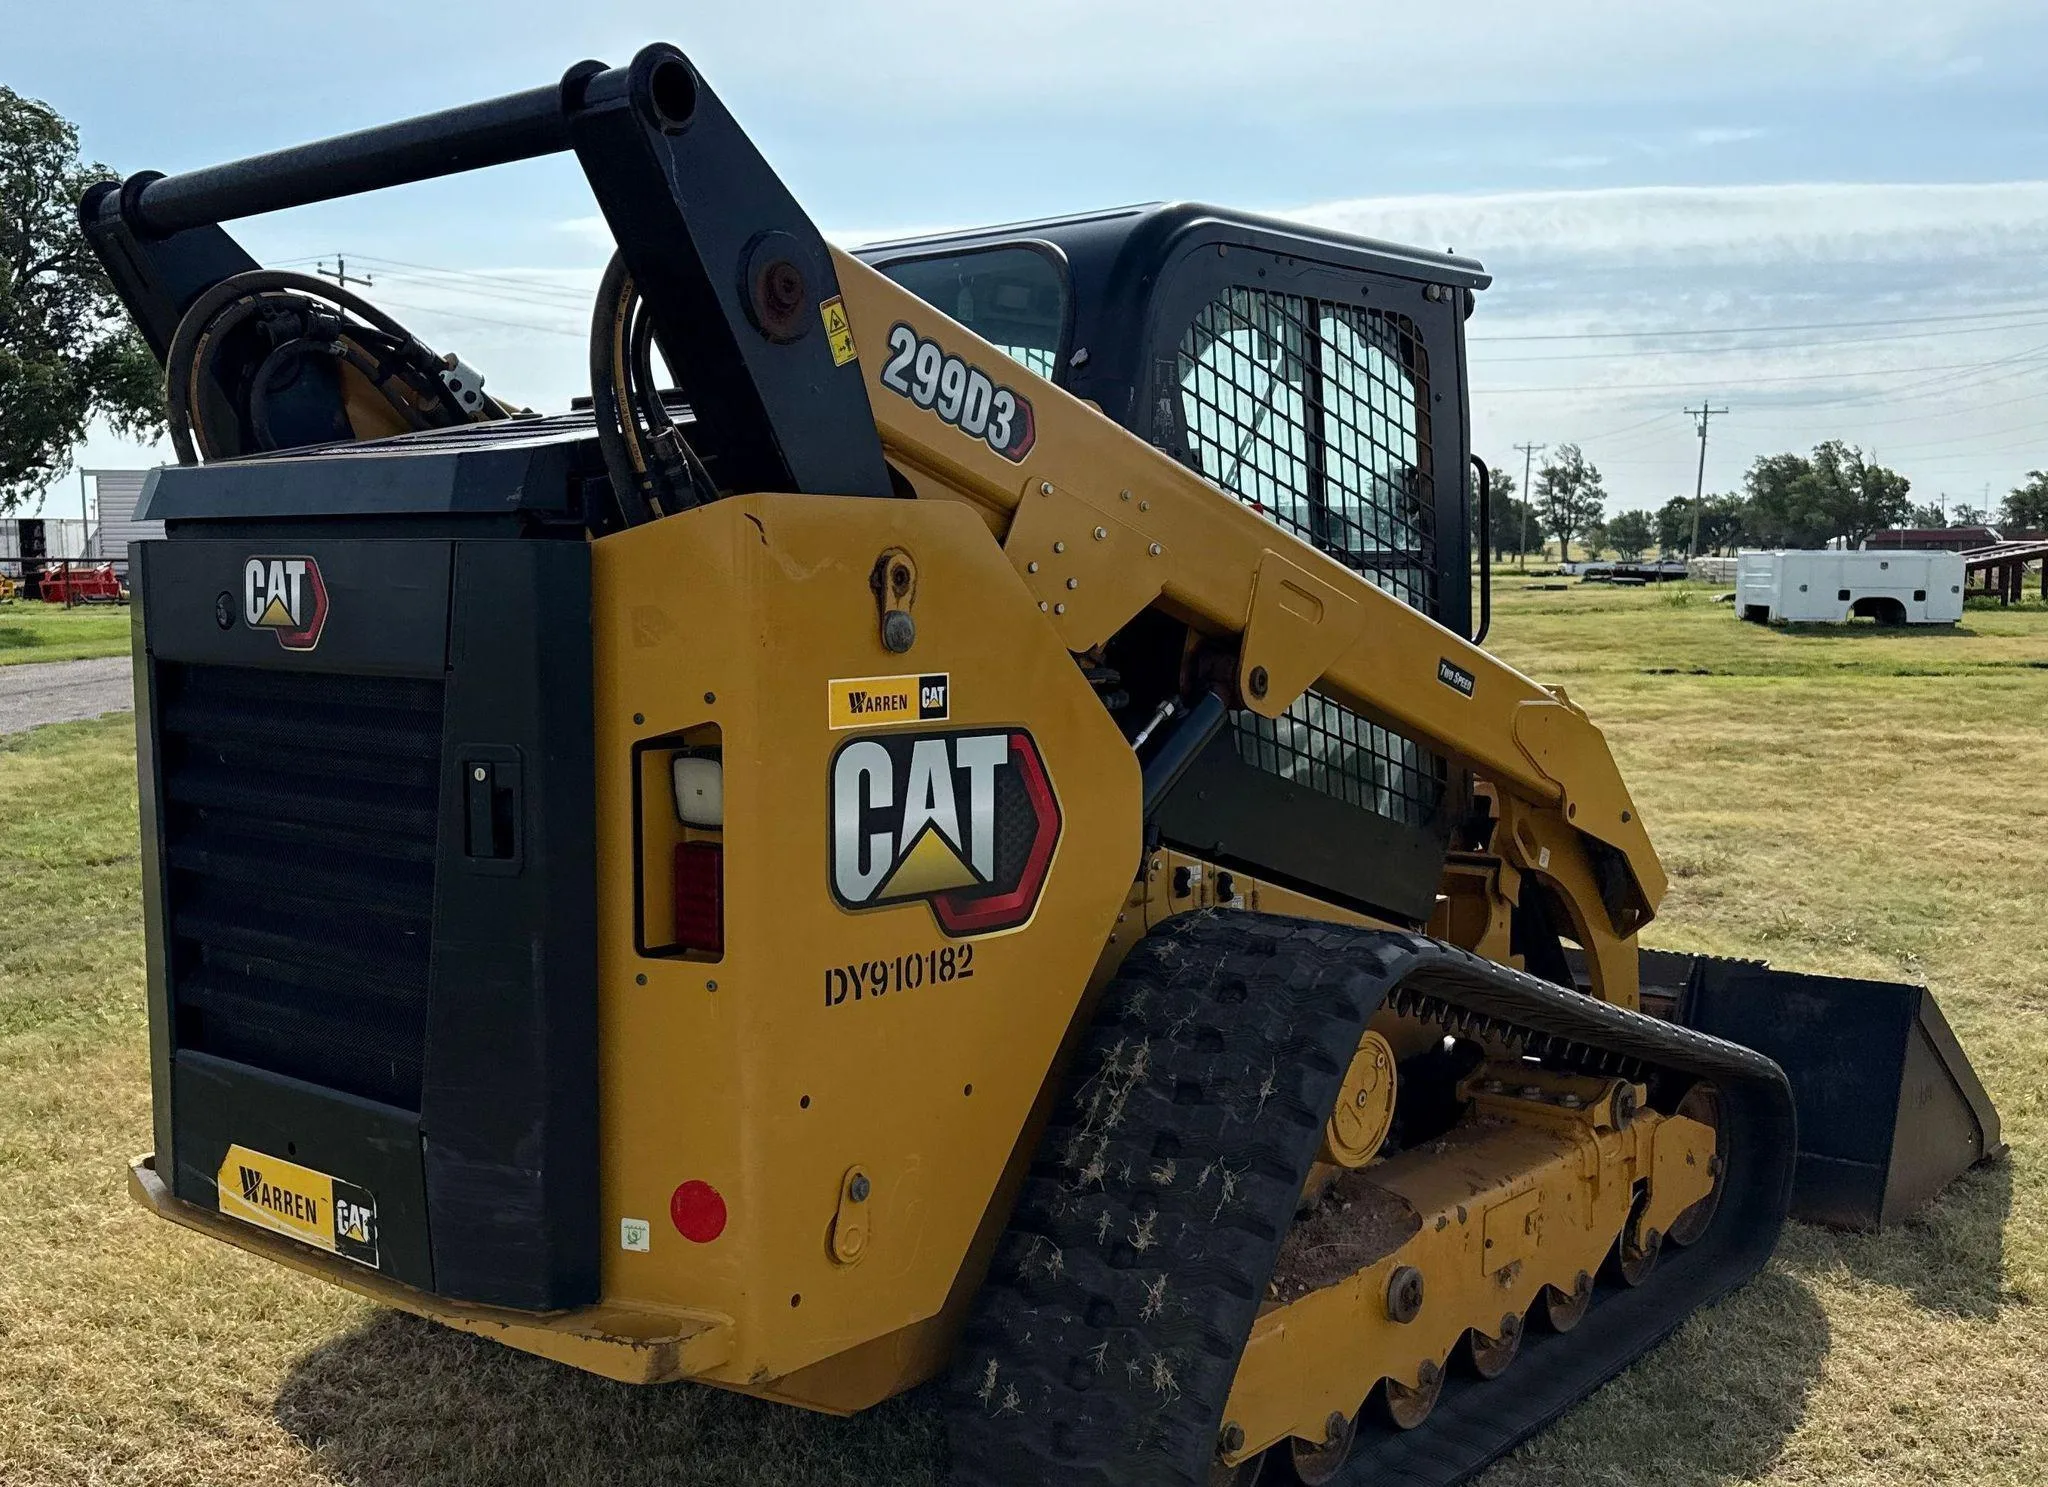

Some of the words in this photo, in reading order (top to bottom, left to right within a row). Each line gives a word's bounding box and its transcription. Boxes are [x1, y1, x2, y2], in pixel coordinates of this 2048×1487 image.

[883, 326, 1017, 449] 299D3
[245, 559, 306, 627] CAT
[848, 691, 908, 714] WARREN
[921, 685, 945, 709] CAT
[1453, 671, 1473, 691] SPEED
[834, 733, 1009, 903] CAT
[825, 943, 975, 1007] DY910182
[238, 1165, 318, 1225] WARREN
[336, 1199, 372, 1244] CAT
